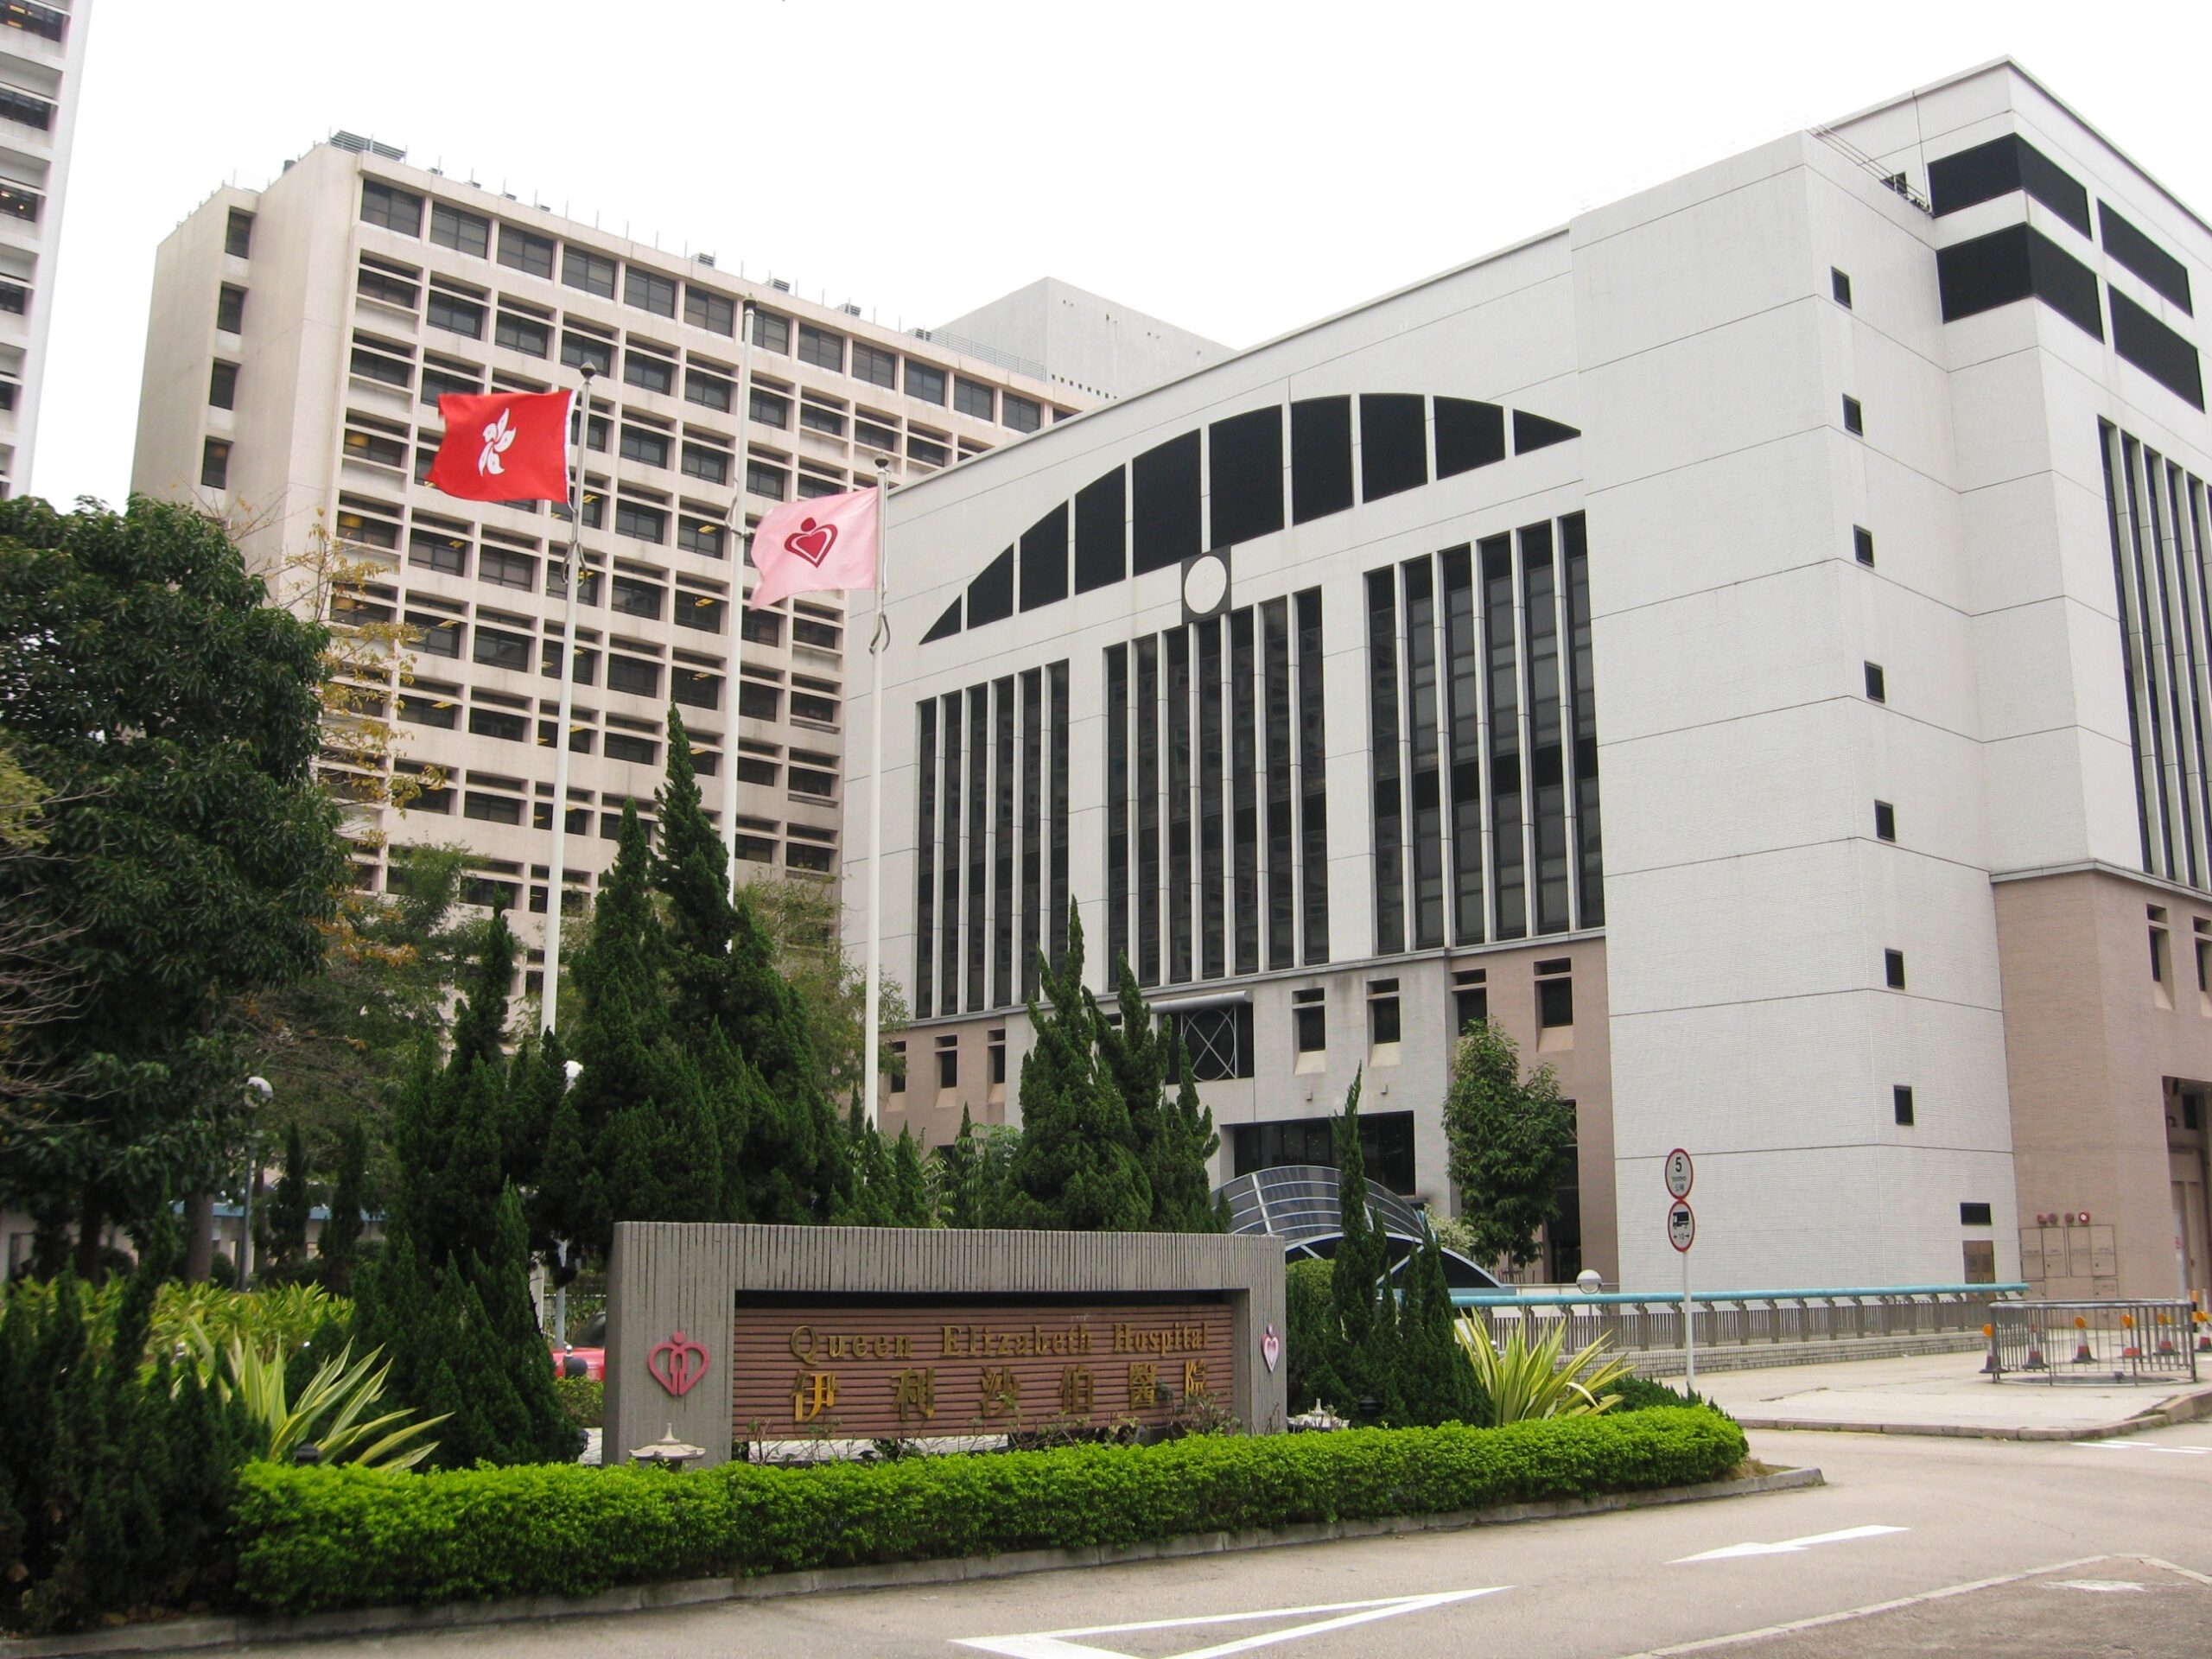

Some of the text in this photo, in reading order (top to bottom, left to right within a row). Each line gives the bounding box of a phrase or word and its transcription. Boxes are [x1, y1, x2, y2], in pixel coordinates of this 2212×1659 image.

[1675, 1156, 1682, 1173] 5
[790, 1321, 1209, 1365] Queen Elizabeth Hospital
[790, 1357, 1207, 1423] 伊利沙伯醫院
